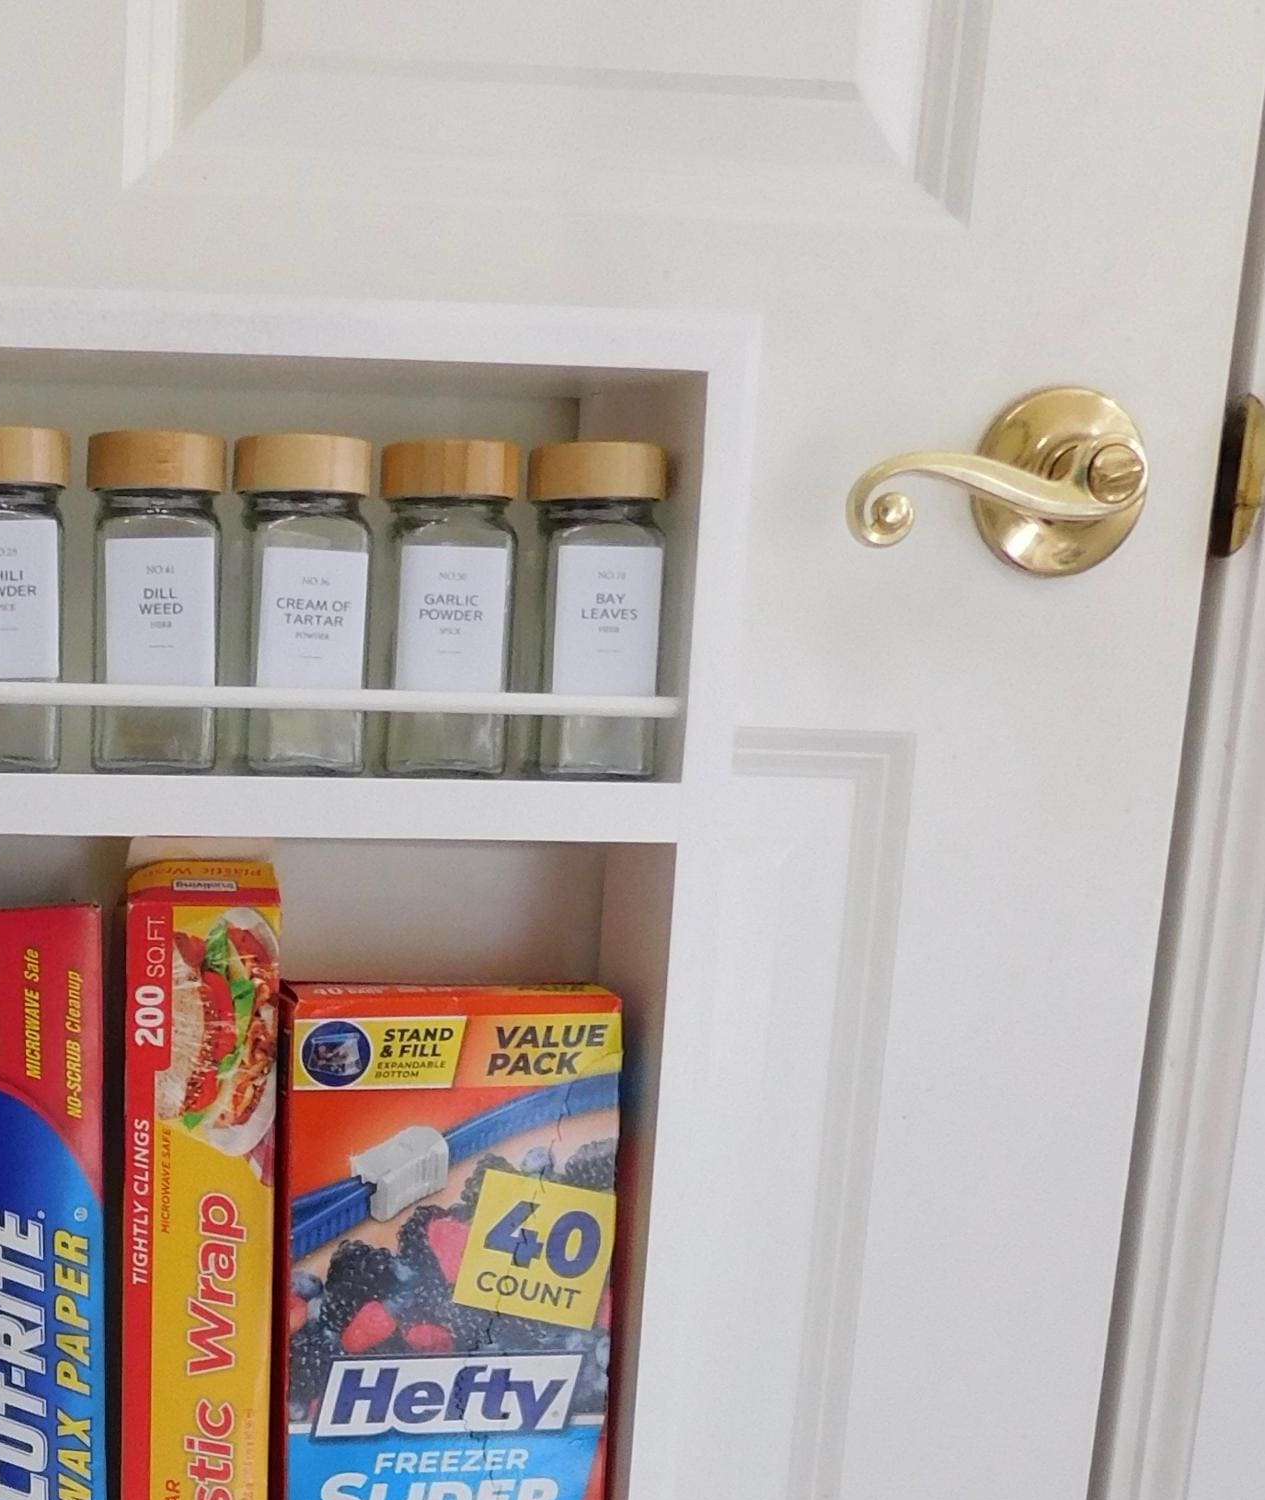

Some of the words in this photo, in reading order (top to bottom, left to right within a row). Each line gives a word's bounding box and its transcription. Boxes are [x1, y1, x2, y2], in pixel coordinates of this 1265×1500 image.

[143, 587, 178, 600] DILL
[276, 597, 326, 612] CREAM
[329, 600, 352, 612] OF
[423, 593, 479, 607] GARLIC
[596, 593, 626, 605] BAY
[138, 602, 183, 616] WEED
[284, 612, 344, 627] TARTAR
[419, 608, 483, 622] POWDER
[581, 608, 638, 621] LEAVES
[200, 867, 263, 878] Plastic
[24, 948, 40, 983] Safe
[65, 970, 84, 1034] Cleanup
[134, 985, 165, 1048] 200
[23, 989, 41, 1080] MICROWAVE
[383, 1027, 454, 1042] STAND
[496, 1024, 609, 1049] VALUE
[379, 1044, 393, 1058] &
[398, 1044, 442, 1058] FILL
[486, 1051, 581, 1077] PACK
[374, 1070, 419, 1079] BOTTOM
[376, 1059, 447, 1070] EXPANDABLE
[65, 1039, 82, 1120] NO-SCRUB
[133, 1118, 150, 1196] CLINGS
[161, 1128, 172, 1160] SAFE
[161, 1161, 172, 1234] MICROWAVE
[132, 1200, 148, 1285] TIGHTLY
[484, 1200, 602, 1279] 40
[186, 1192, 247, 1376] Wrap
[476, 1270, 581, 1310] COUNT
[53, 1228, 91, 1397] PAPER
[330, 1365, 568, 1430] Hefty
[374, 1448, 529, 1475] FREEZER
